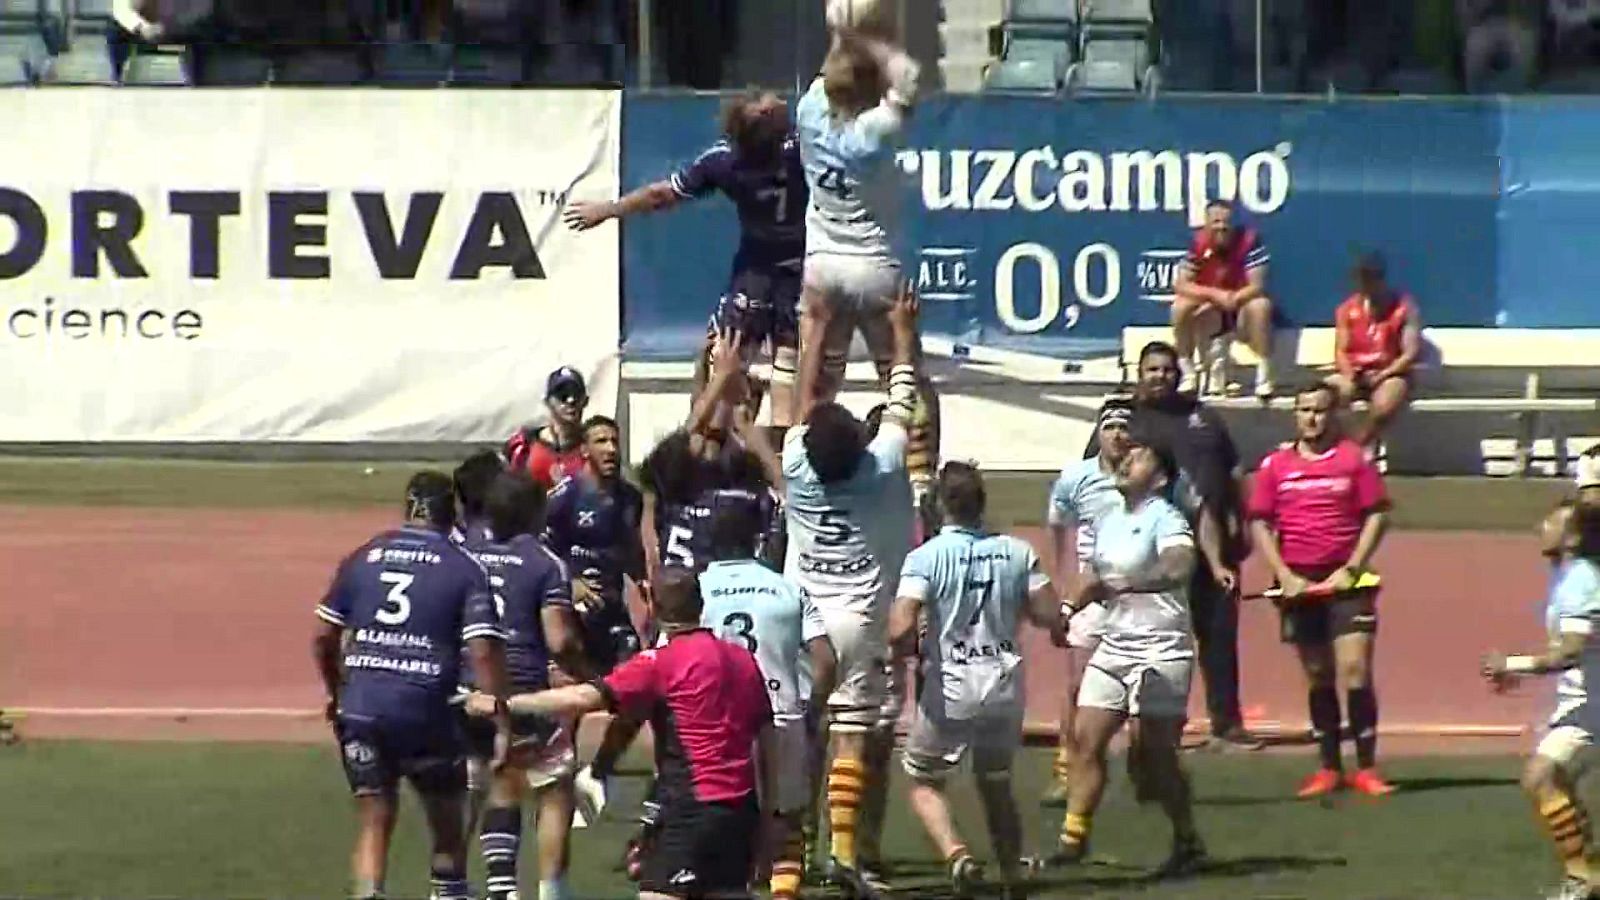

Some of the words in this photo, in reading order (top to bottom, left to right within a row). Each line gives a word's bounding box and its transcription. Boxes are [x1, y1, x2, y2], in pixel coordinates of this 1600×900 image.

[918, 261, 977, 287] ALC.
[9, 297, 203, 339] cience
[664, 525, 695, 568] 5
[375, 571, 415, 625] 3
[969, 580, 994, 625] 7
[723, 612, 757, 653] 3
